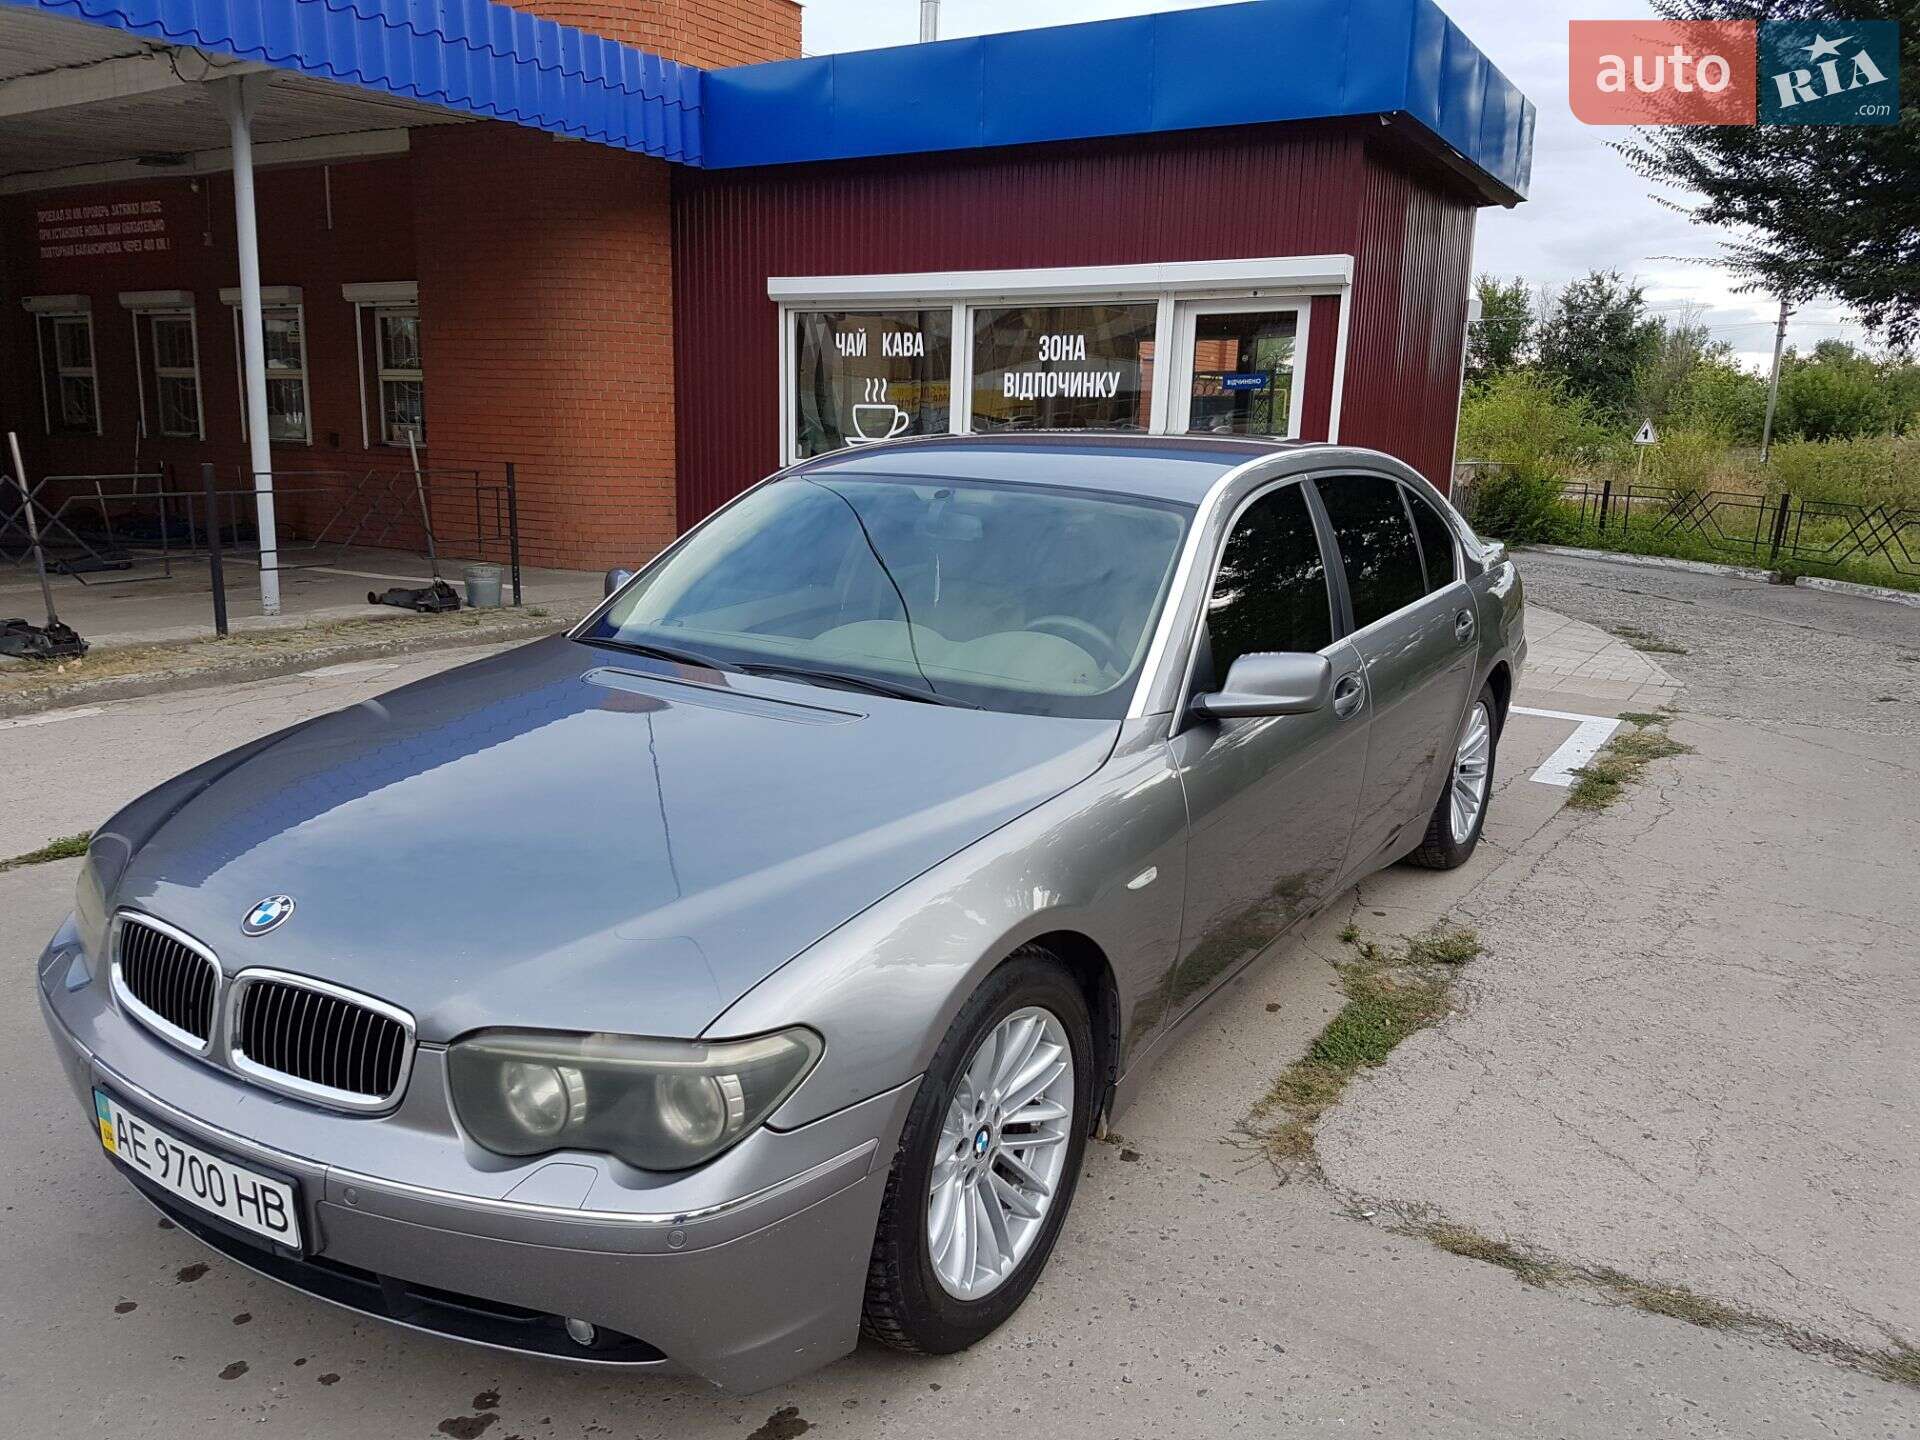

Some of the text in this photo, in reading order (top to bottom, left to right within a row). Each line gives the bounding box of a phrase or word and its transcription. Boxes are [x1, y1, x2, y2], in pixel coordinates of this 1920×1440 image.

[835, 328, 924, 357] ЧАЙ КАВА
[1038, 334, 1086, 361] ЗОНА
[1003, 371, 1120, 400] ВІДПОЧИНКУ
[116, 1112, 289, 1233] AE 9700 HB
